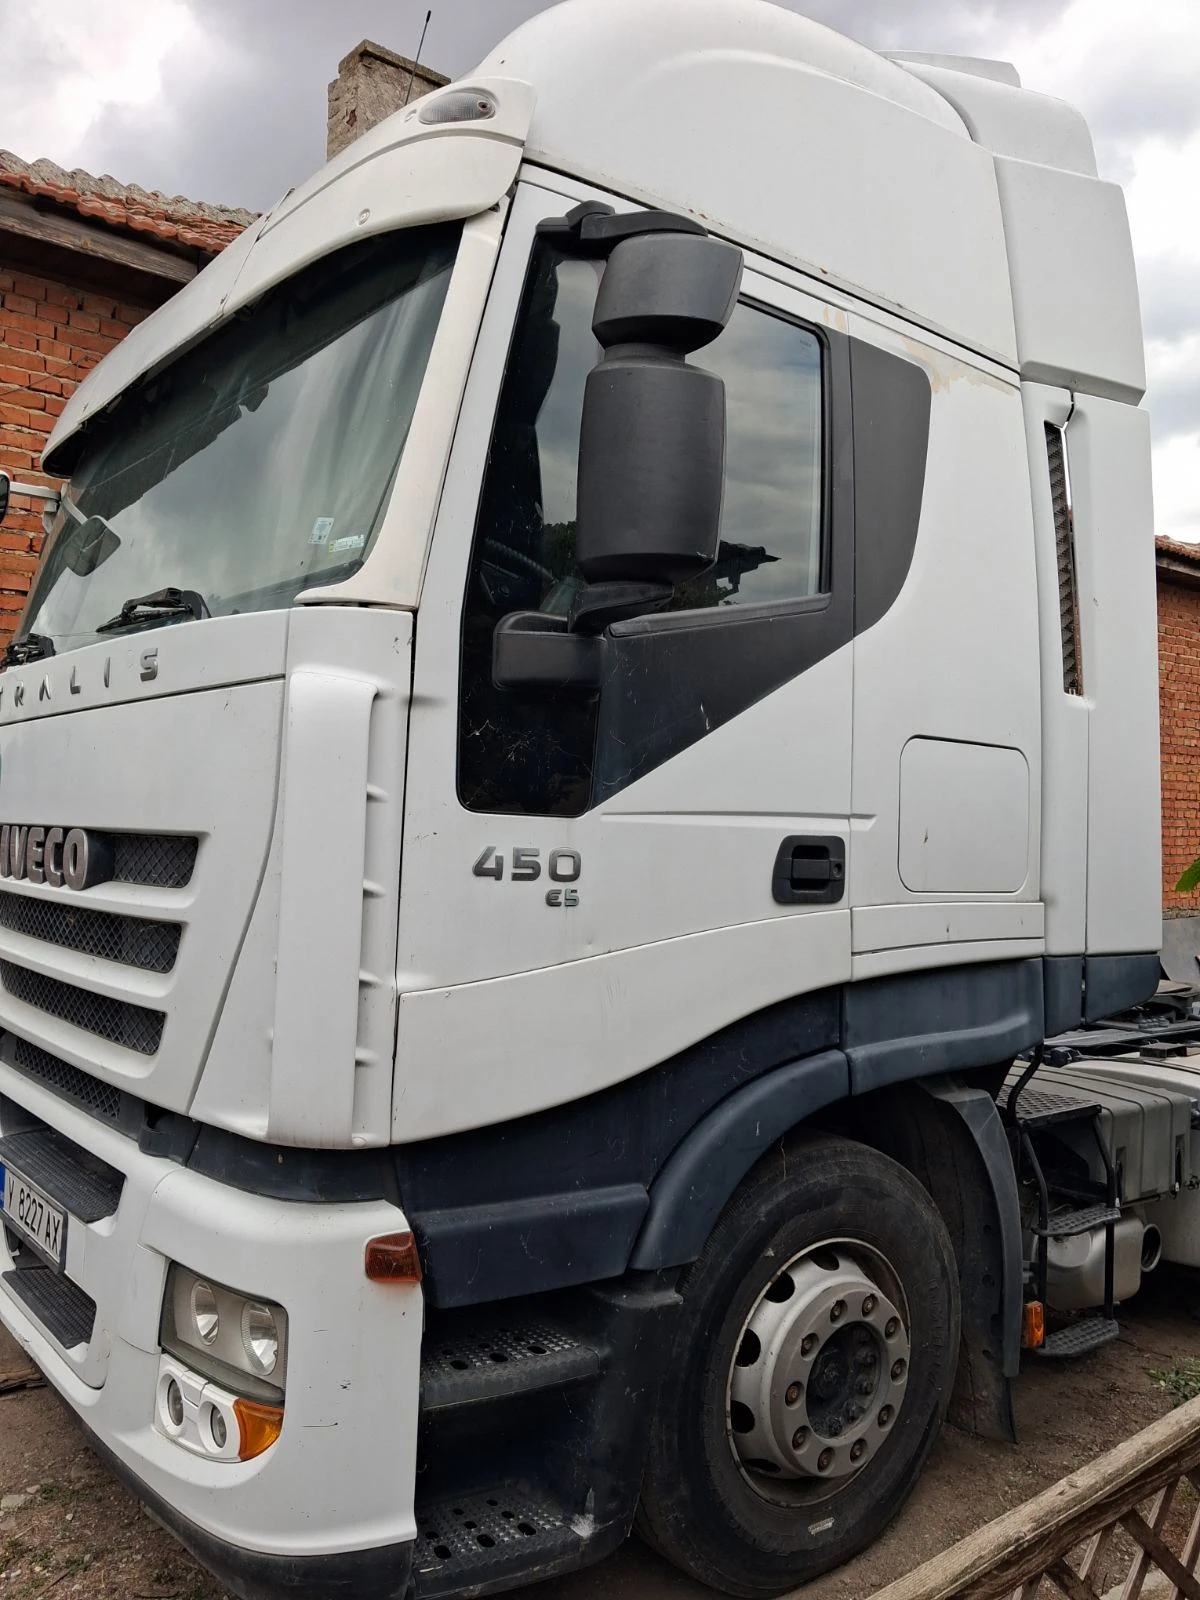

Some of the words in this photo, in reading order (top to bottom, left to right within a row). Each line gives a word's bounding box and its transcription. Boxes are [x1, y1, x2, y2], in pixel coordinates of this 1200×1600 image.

[0, 825, 89, 891] IVECO
[472, 846, 581, 882] 450
[545, 888, 580, 907] E5
[18, 1187, 44, 1237] 8227
[44, 1210, 61, 1255] AX
